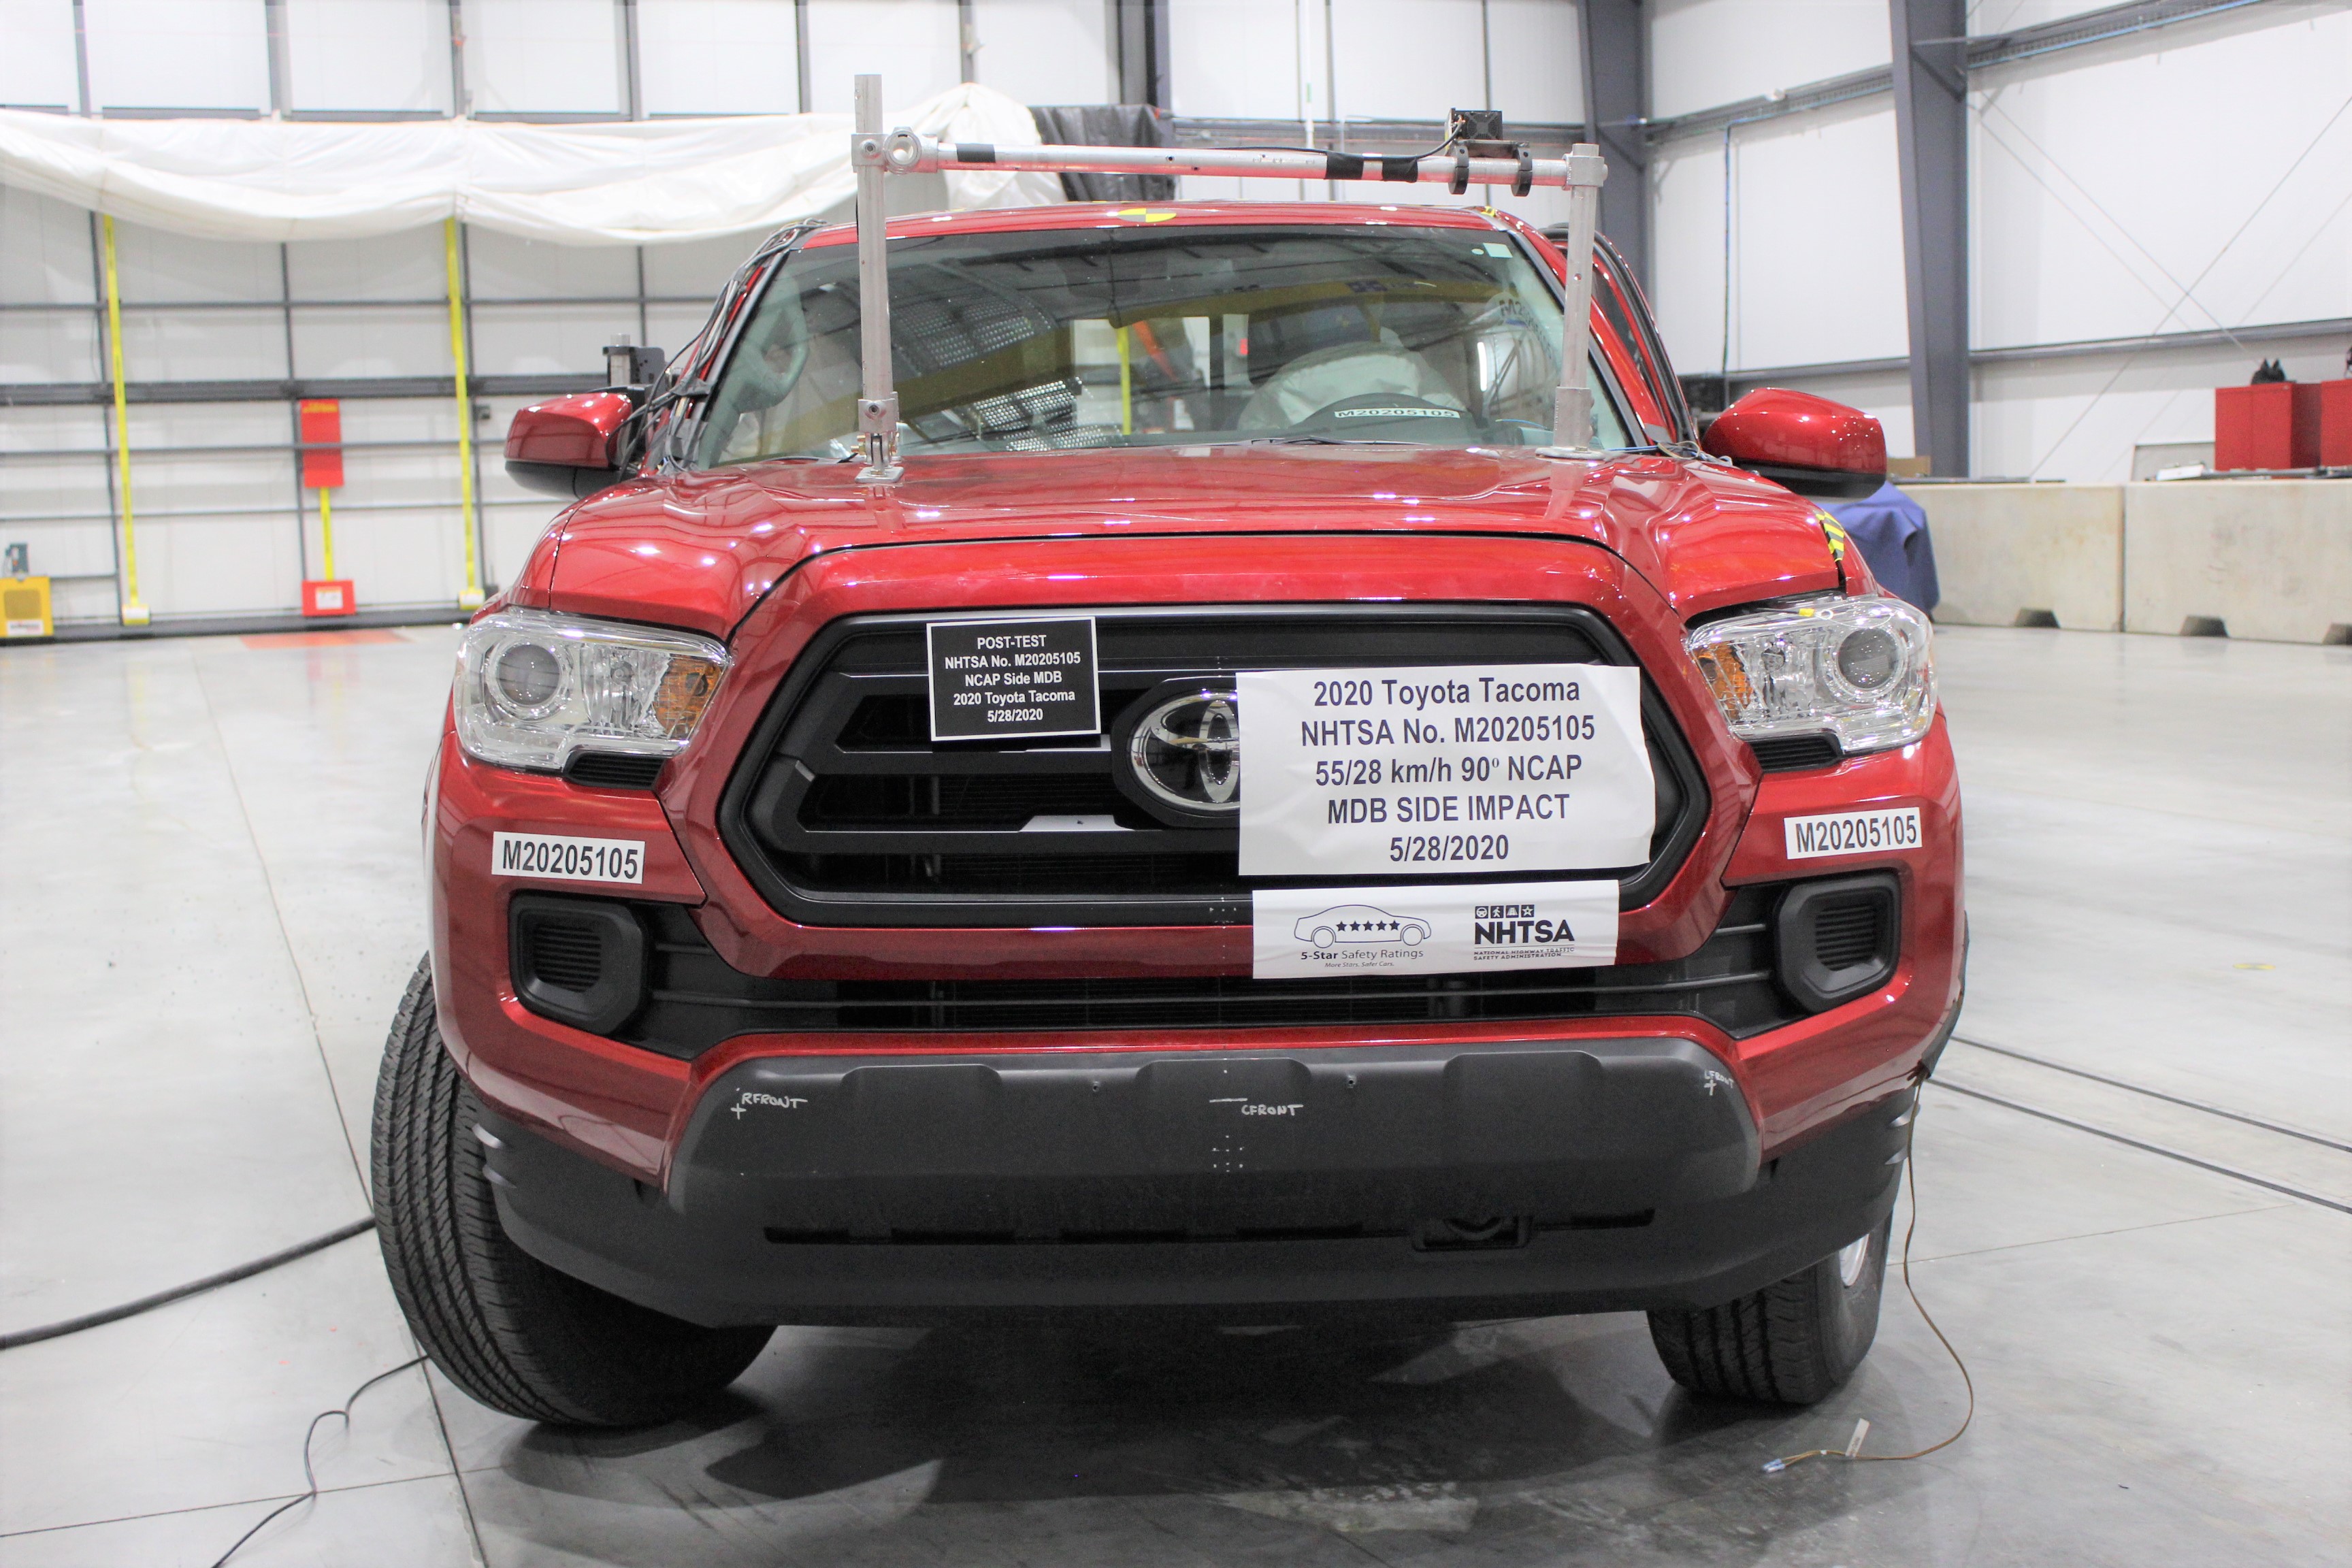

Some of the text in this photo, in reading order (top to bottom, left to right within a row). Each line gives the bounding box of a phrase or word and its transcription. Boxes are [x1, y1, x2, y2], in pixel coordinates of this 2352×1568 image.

[1338, 409, 1455, 417] M20205105
[977, 635, 1047, 649] POST-TEST
[945, 651, 1081, 669] NHTSA No. M20205105
[965, 670, 1062, 687] NCAP Side MDB
[953, 690, 1075, 706] 2020 Toyota Tacoma
[1313, 677, 1580, 710] 2020 Toyota Tacoma
[987, 708, 1043, 722] 5/28/2020
[1301, 715, 1595, 747] NHTSA No. M20205105
[1316, 760, 1382, 786] 55/28
[1391, 757, 1452, 783] km/h
[1507, 755, 1582, 781] NCAP
[1328, 794, 1570, 824] MDB SIDE IMPACT
[1795, 815, 1916, 853] M20205105
[1390, 834, 1509, 862] 5/28/2020
[503, 840, 638, 879] M20205105
[1474, 919, 1575, 945] NHTSA
[1301, 949, 1424, 960] 5-Star Safety Ratings
[741, 1092, 808, 1109] RFRONT
[1241, 1105, 1304, 1115] CFRONT
